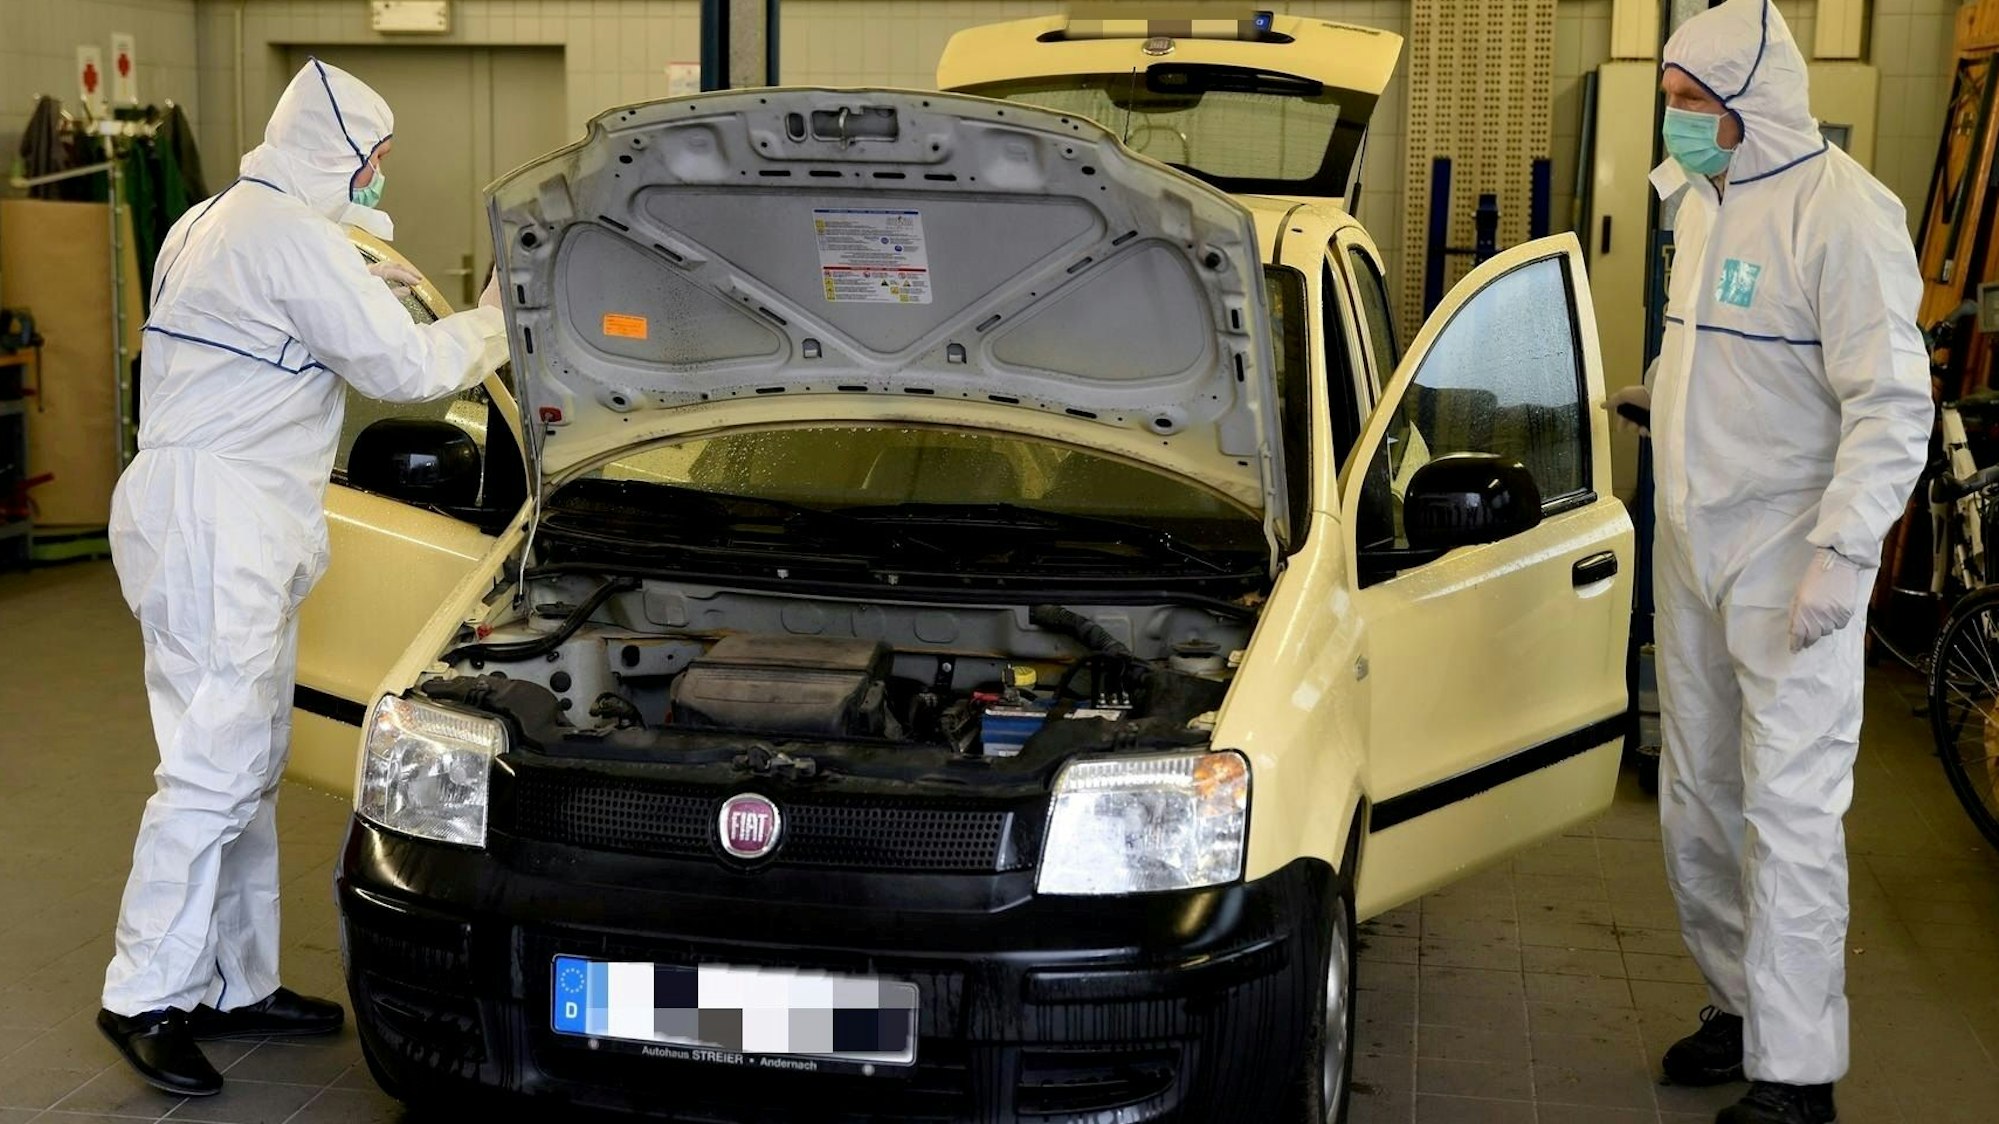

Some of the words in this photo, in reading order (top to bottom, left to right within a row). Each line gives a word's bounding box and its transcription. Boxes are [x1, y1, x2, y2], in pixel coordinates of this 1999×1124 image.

[730, 810, 769, 842] FIAT
[565, 1001, 578, 1019] D
[642, 1045, 690, 1060] Autohaus
[760, 1056, 818, 1072] Andernach
